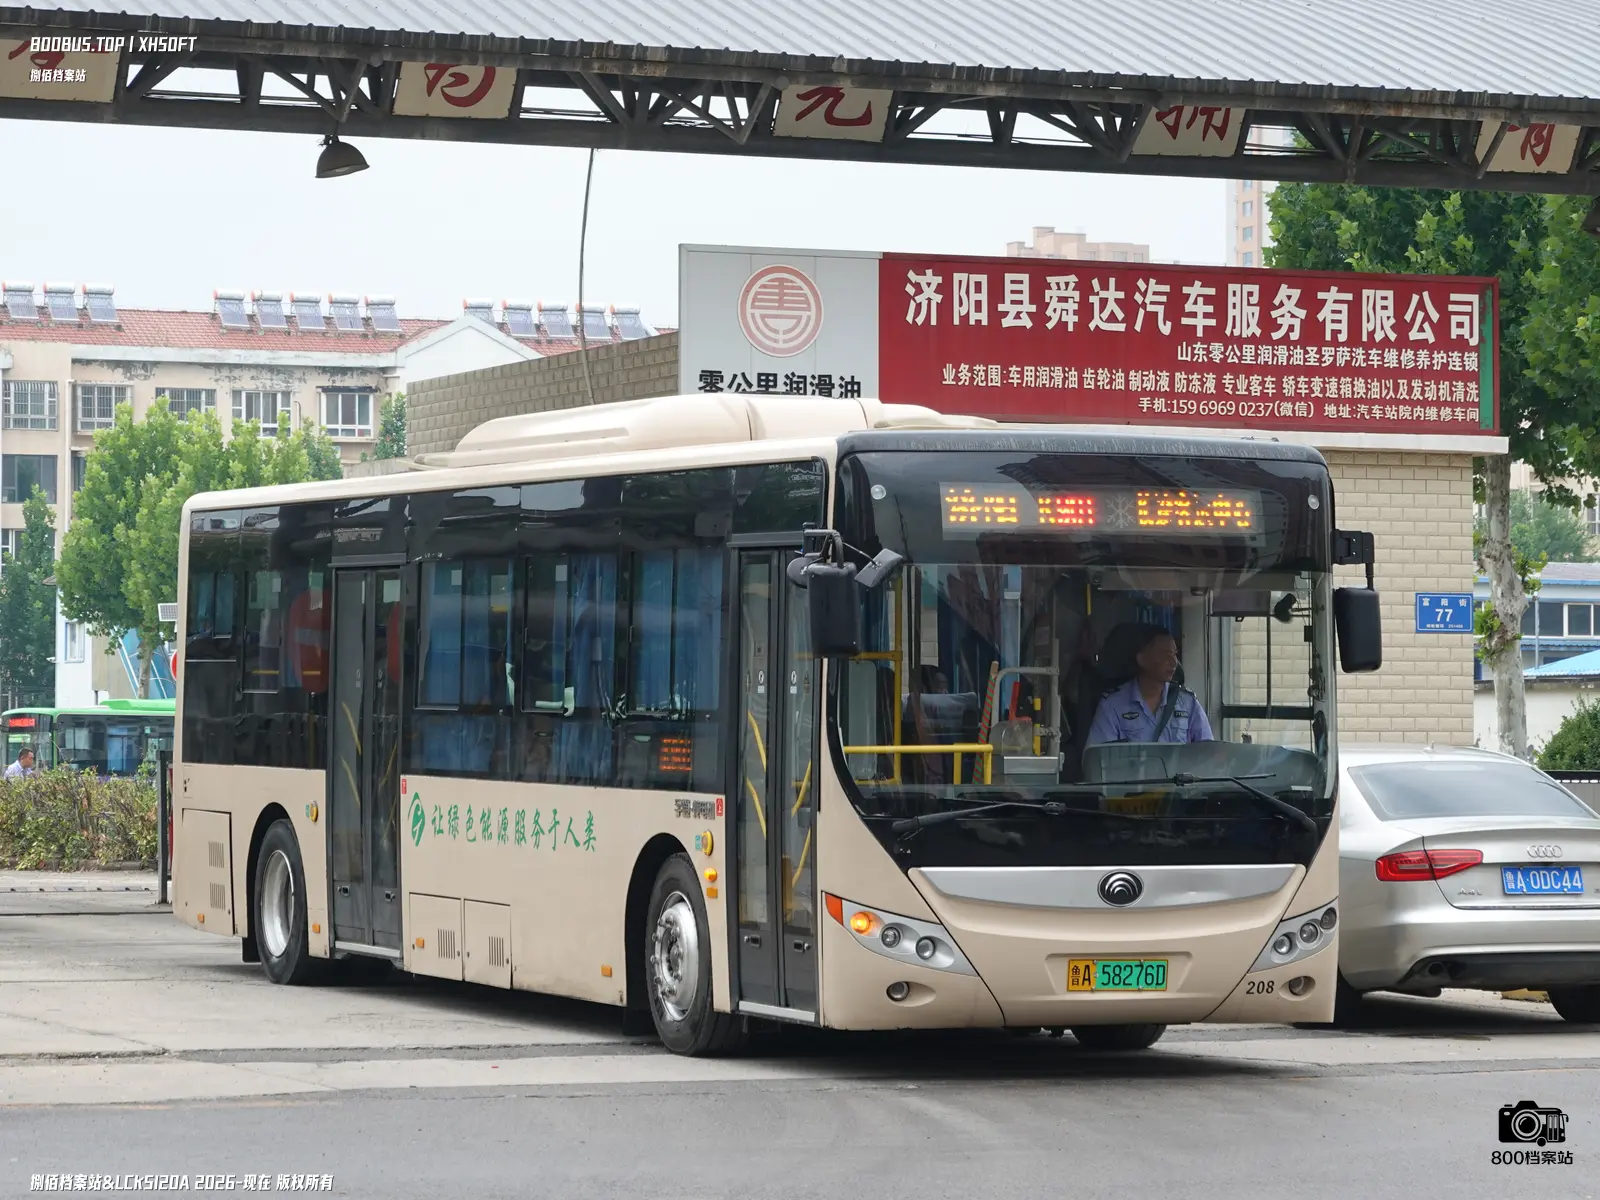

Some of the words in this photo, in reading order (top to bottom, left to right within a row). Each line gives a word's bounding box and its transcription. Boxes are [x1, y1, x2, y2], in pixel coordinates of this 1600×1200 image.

[904, 268, 1480, 346] 济阳县舜达汽车服务有限公司
[1176, 341, 1480, 372] 山东零公里润滑油圣罗萨洗车维修养护连锁
[697, 369, 863, 399] 零公里润滑油
[942, 363, 1079, 389] 业务范围:车用润滑油
[1082, 368, 1126, 391] 齿轮油
[1128, 370, 1170, 393] 制动液
[1174, 371, 1217, 395] 防冻液
[1221, 372, 1277, 398] 专业客车
[1282, 375, 1480, 403] 轿车变速箱换油以及发动机清洗
[1138, 397, 1197, 415] 手机:159
[1199, 399, 1236, 417] 6969
[1238, 401, 1315, 419] 0237(微信)
[1323, 403, 1480, 423] 地址:汽车站院内维修车间
[1435, 608, 1453, 622] 77
[431, 802, 597, 853] 让绿色能源服务于人类
[1246, 980, 1275, 995] 208
